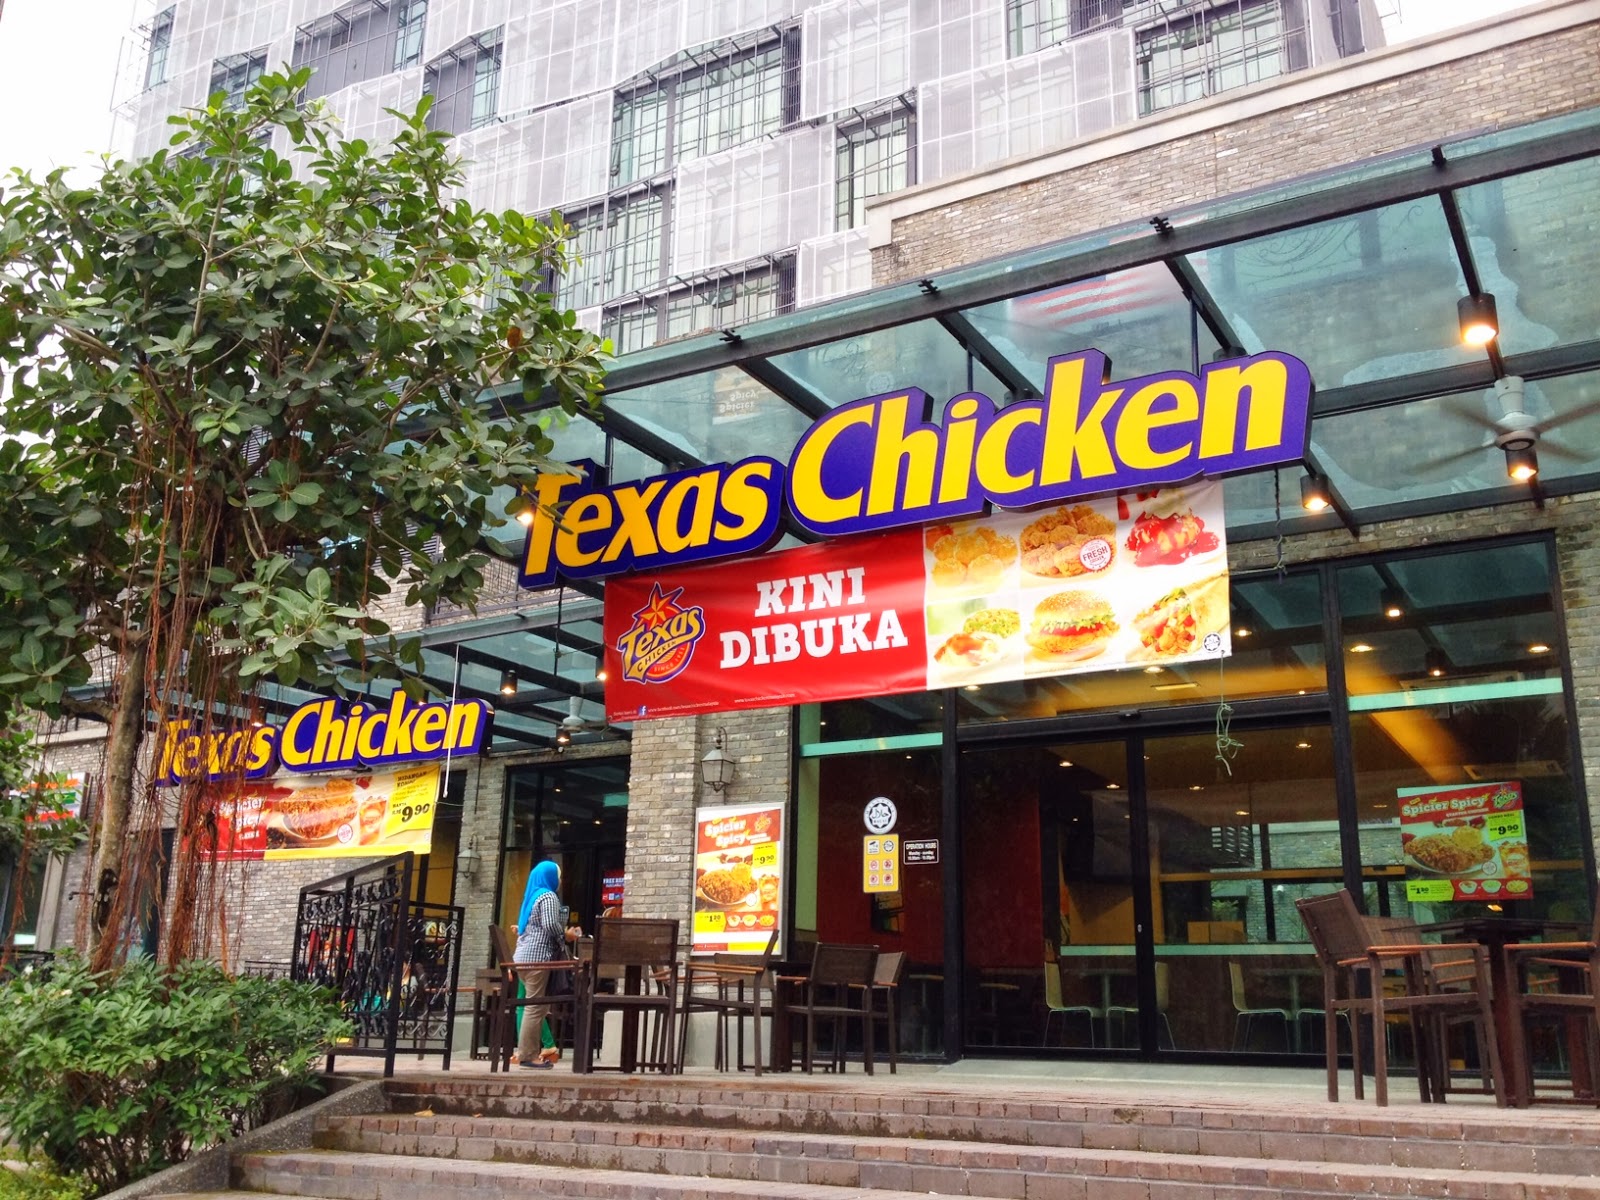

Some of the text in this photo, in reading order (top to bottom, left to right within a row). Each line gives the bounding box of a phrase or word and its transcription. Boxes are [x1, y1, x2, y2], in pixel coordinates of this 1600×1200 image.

[525, 358, 1288, 576] Texas Chicken
[1082, 545, 1109, 561] FRESH
[754, 567, 866, 617] KINI
[620, 608, 701, 670] Texas
[637, 640, 677, 672] CHICKEN
[719, 609, 909, 669] DIBUKA
[280, 690, 481, 765] Chicken
[1402, 800, 1449, 816] Spicier
[1451, 796, 1486, 811] Spicy
[704, 820, 747, 838] Spicier
[715, 833, 747, 848] Spicy
